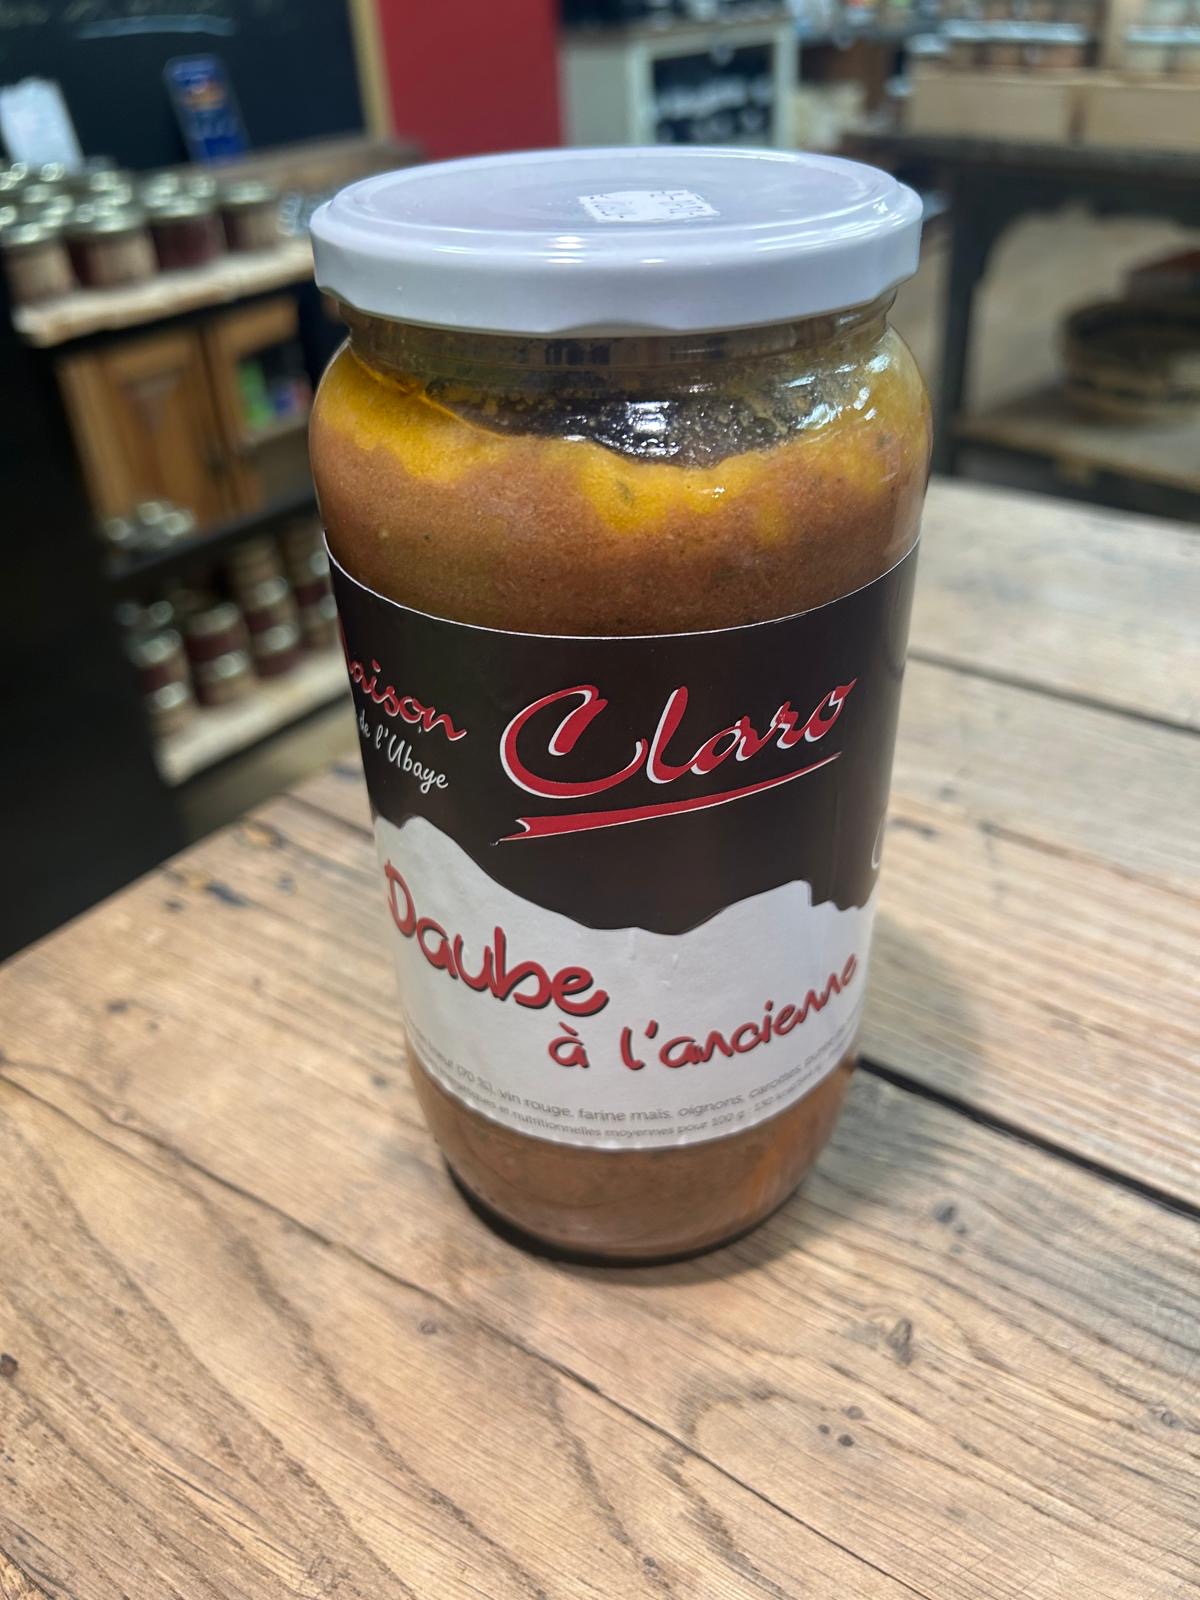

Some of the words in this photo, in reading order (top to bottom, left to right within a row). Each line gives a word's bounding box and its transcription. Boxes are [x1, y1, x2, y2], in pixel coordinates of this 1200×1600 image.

[340, 634, 467, 741] aison
[500, 679, 857, 799] Claro
[376, 724, 449, 794] l'Ubaye
[384, 859, 610, 1017] Daube
[548, 1021, 590, 1069] à
[620, 953, 857, 1071] l'ancienne
[499, 1089, 521, 1105] vin
[579, 1107, 625, 1121] farine
[677, 1121, 708, 1135] pour
